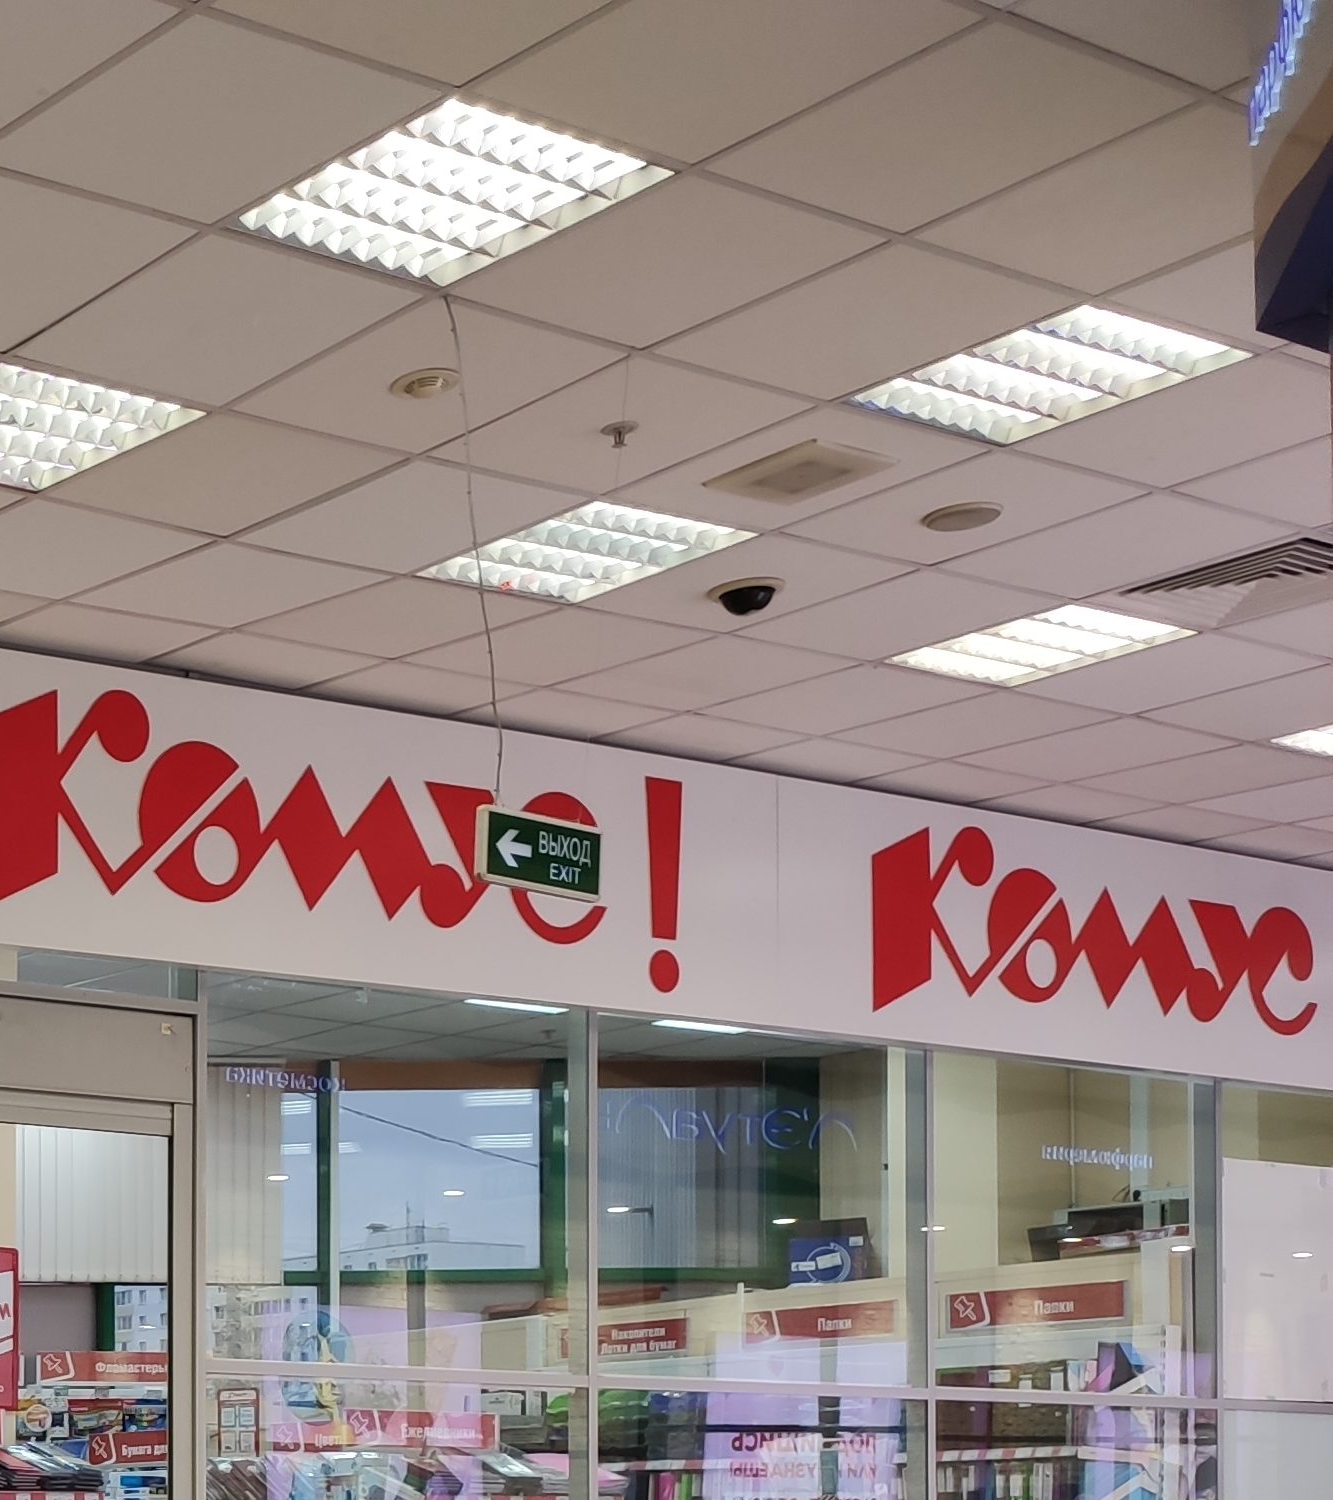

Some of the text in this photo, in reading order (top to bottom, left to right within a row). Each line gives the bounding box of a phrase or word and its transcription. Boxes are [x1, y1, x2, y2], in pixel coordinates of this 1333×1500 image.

[538, 830, 592, 868] ВЫХОД
[549, 863, 581, 884] EXIT
[872, 826, 1317, 1035] Комус
[1034, 1300, 1075, 1315] Папки
[818, 1317, 852, 1332] Папки
